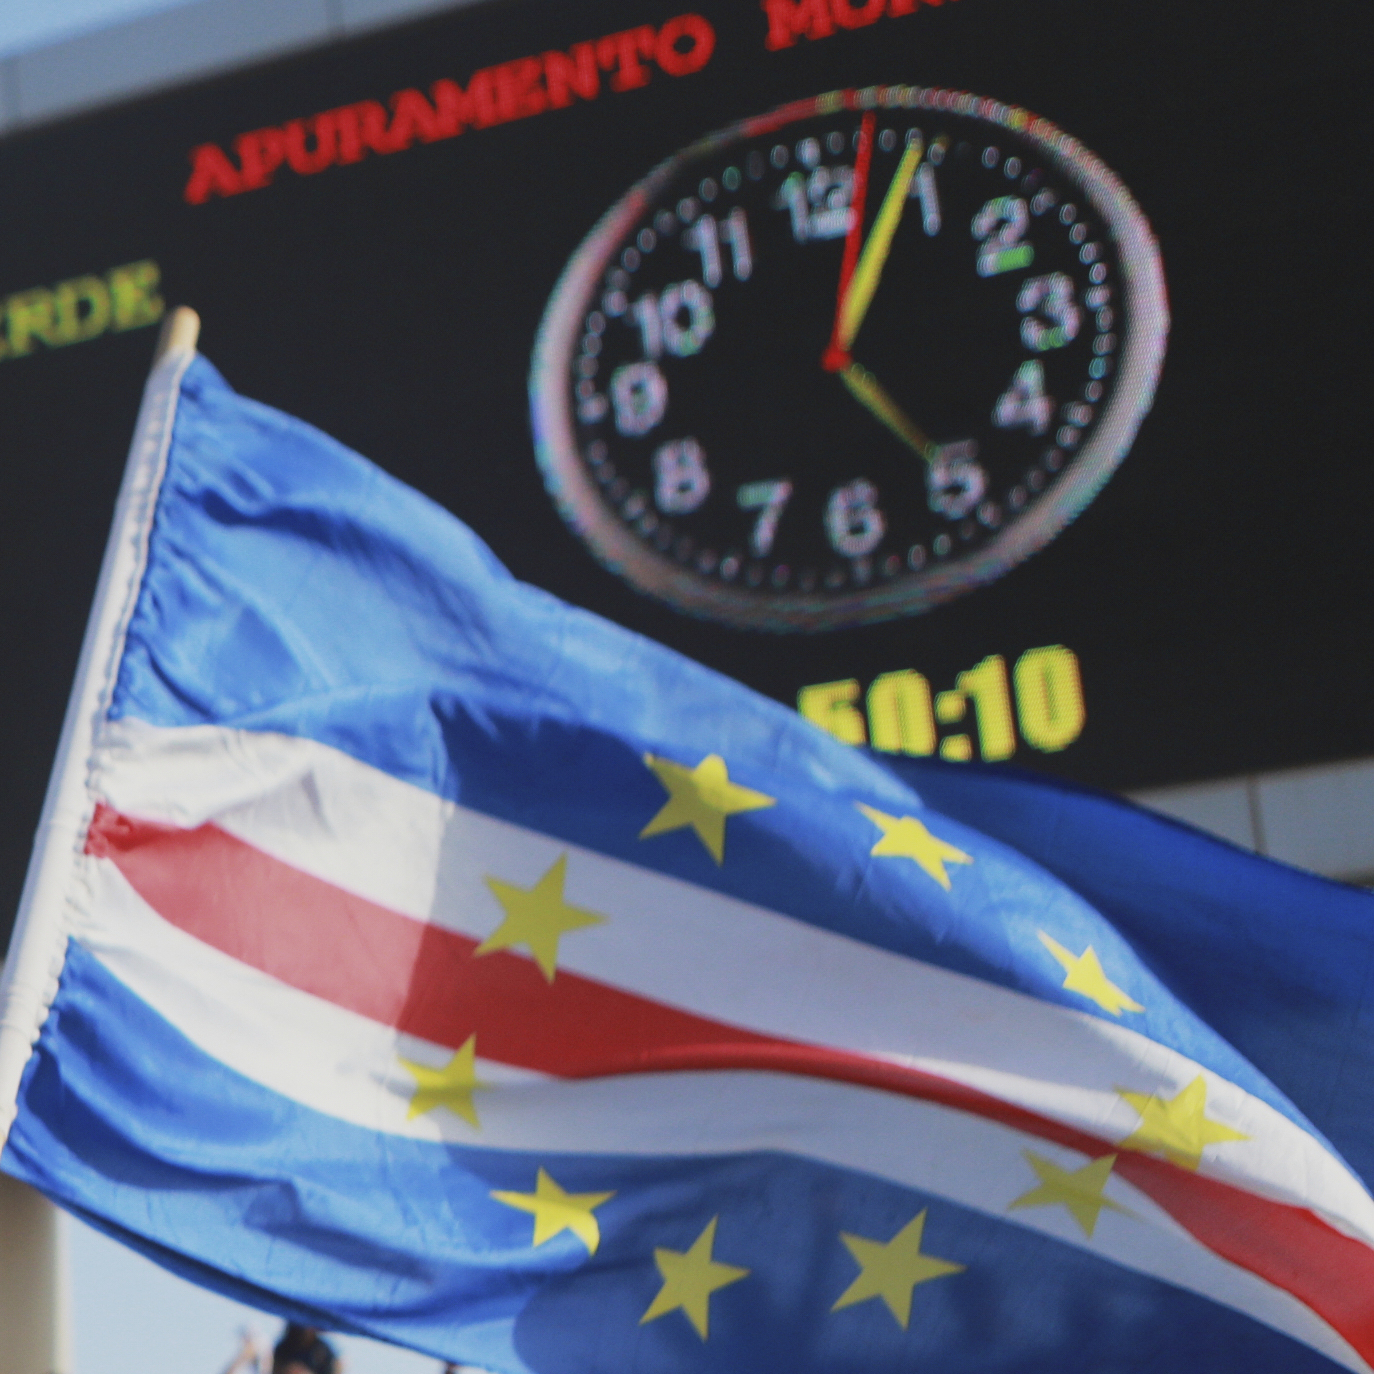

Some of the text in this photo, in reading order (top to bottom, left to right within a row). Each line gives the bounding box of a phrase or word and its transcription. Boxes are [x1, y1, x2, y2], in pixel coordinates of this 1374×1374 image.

[184, 14, 717, 205] APURAMENTO
[776, 165, 860, 244] 12
[908, 161, 942, 237] 1
[971, 195, 1036, 278] 2
[690, 206, 753, 289] 11
[630, 279, 716, 358] 10
[1016, 271, 1080, 352] 3
[608, 360, 669, 438] 9
[993, 359, 1052, 435] 4
[653, 436, 710, 515] 8
[927, 440, 988, 521] 5
[736, 480, 793, 557] 7
[824, 477, 886, 558] 6
[797, 644, 1087, 763] 50:10
